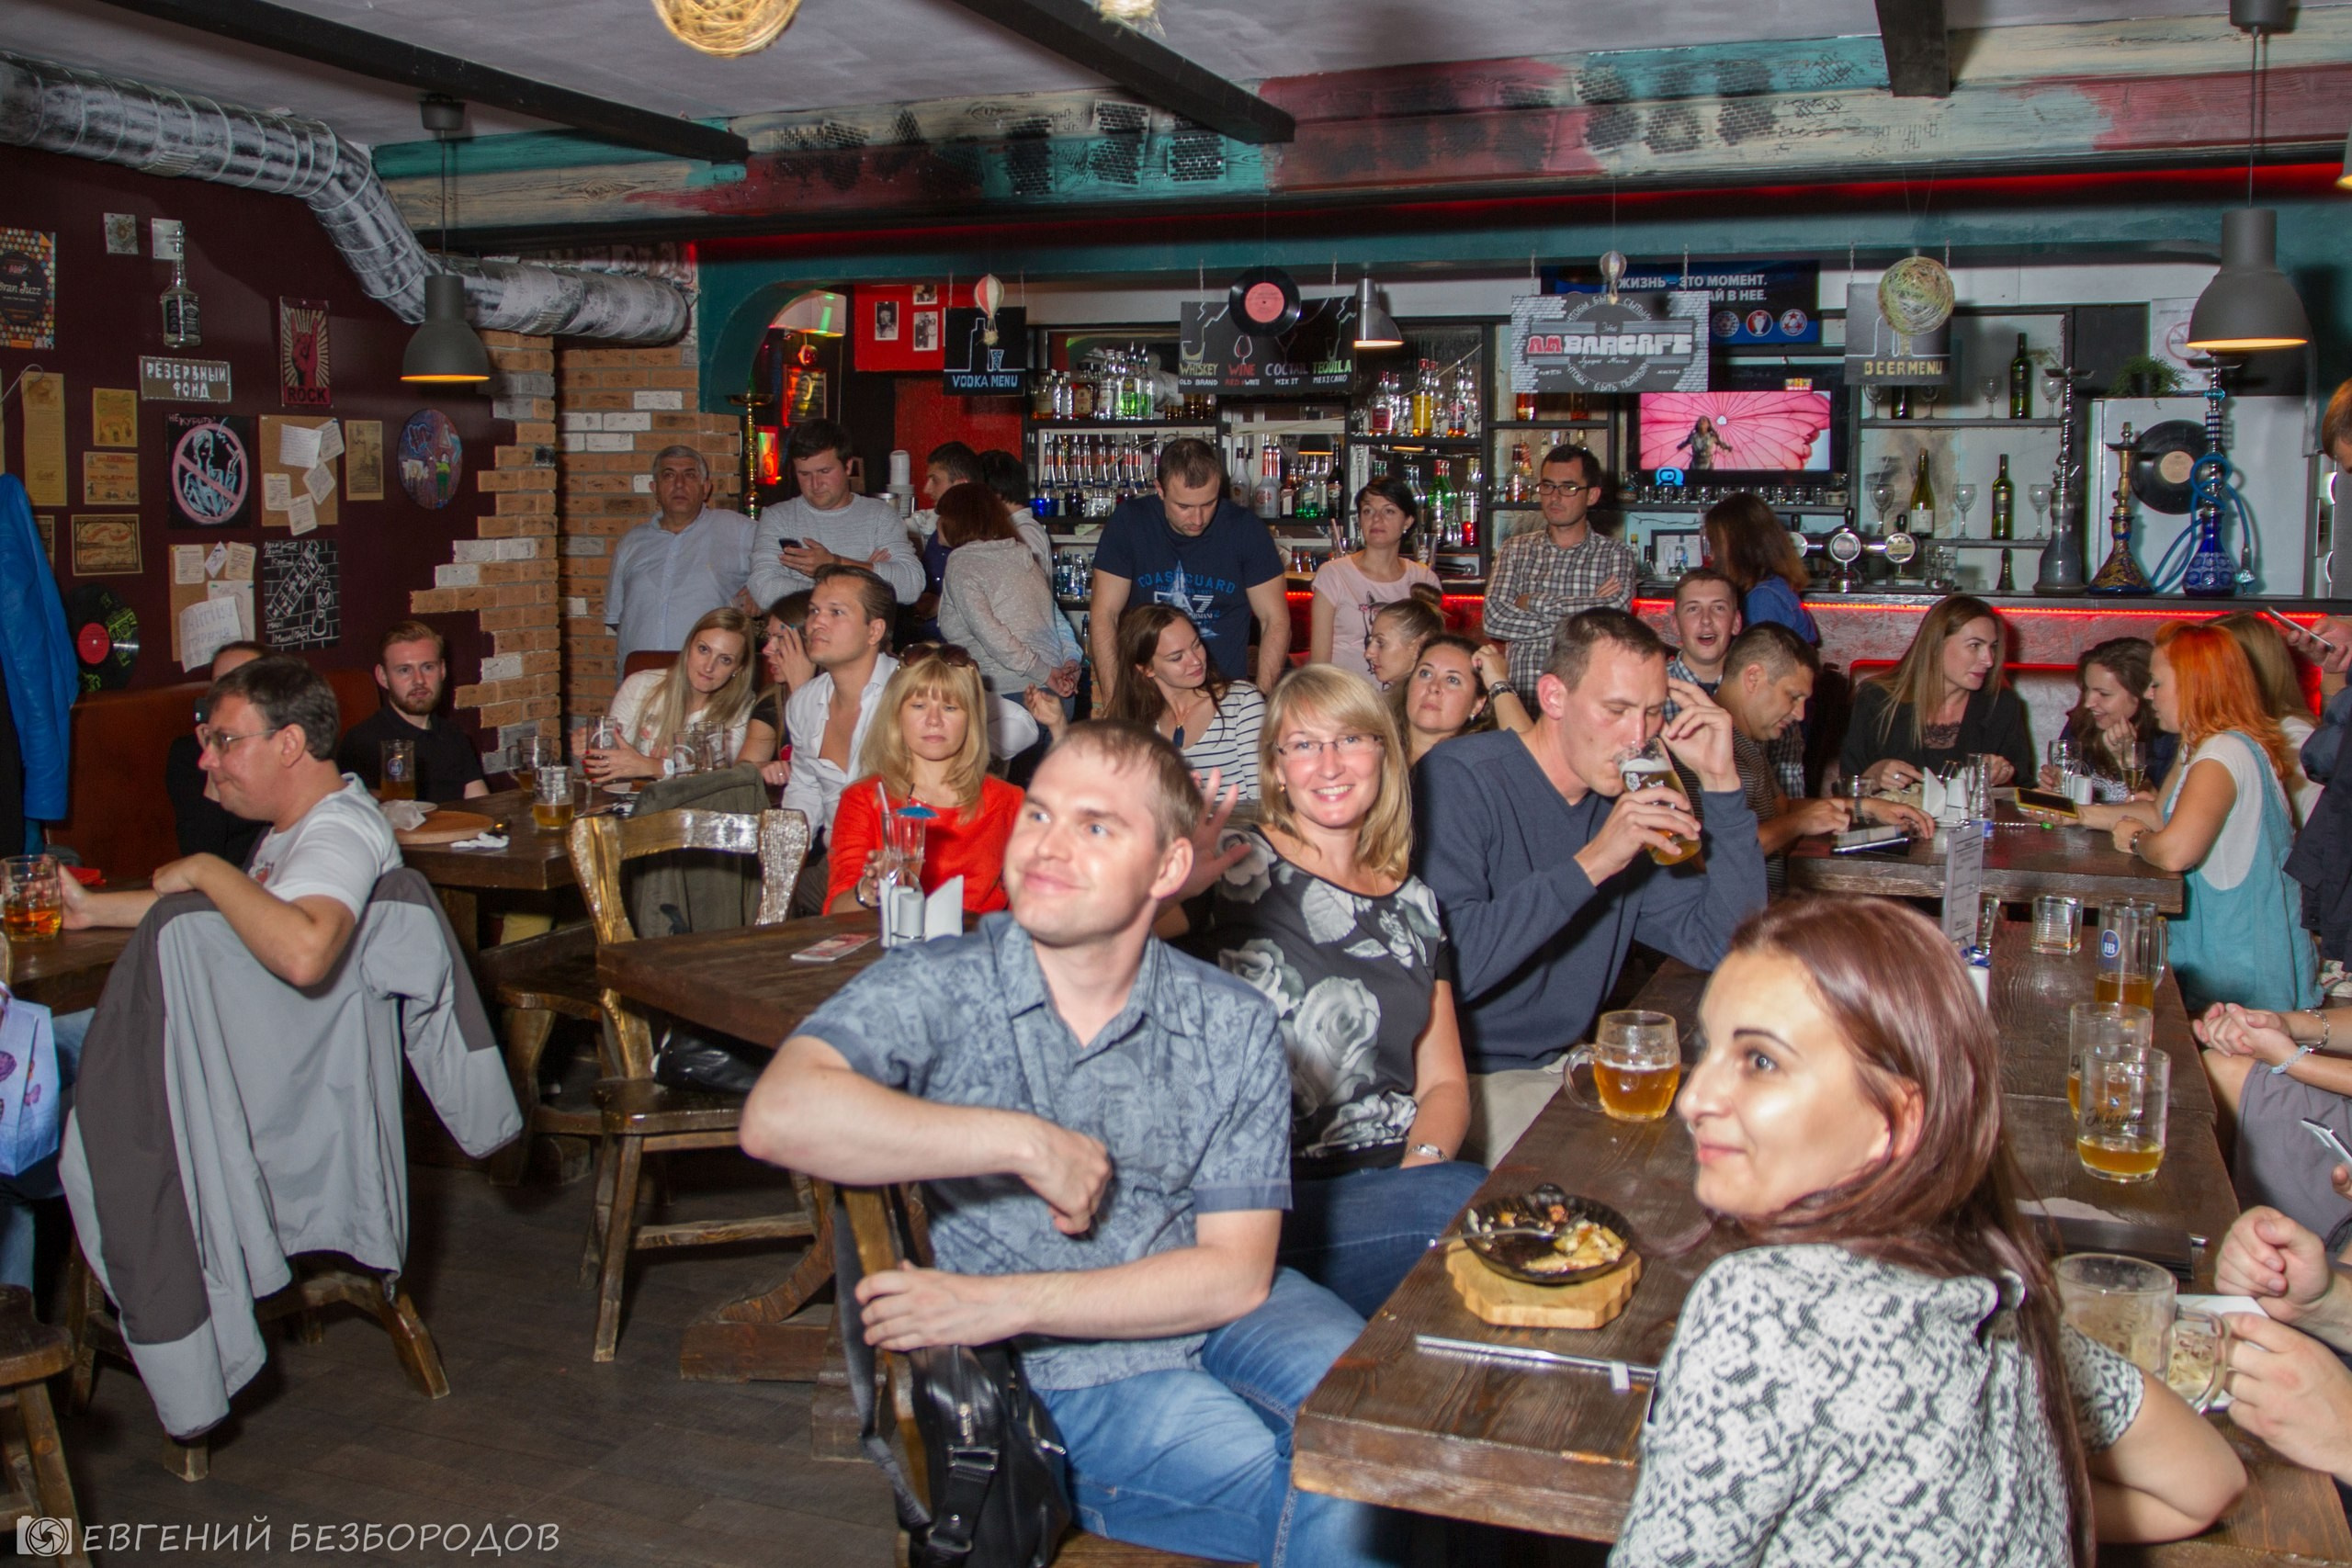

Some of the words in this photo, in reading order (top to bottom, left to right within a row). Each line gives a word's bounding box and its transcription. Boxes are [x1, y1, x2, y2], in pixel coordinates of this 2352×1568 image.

[1617, 276, 1667, 289] ЖИЗНЬ
[1679, 275, 1704, 288] ЭТО
[1706, 273, 1768, 287] МОМЕНТ.
[1591, 294, 1611, 305] БЫТ
[1727, 290, 1737, 301] В
[1739, 288, 1768, 301] НЕЕ.
[1179, 363, 1219, 377] WHISKEY
[1227, 363, 1256, 377] WINE
[1264, 362, 1309, 377] COCTAIL
[1312, 358, 1352, 375] TEQUILA
[952, 375, 989, 388] VODKA
[990, 375, 1018, 388] MENU
[1290, 378, 1299, 386] IT
[1313, 375, 1348, 384] MEXICANO
[172, 380, 211, 400] ФОНД
[1593, 382, 1618, 392] БЫТЬ
[286, 387, 328, 402] ROCK
[1184, 572, 1236, 594] GUARD
